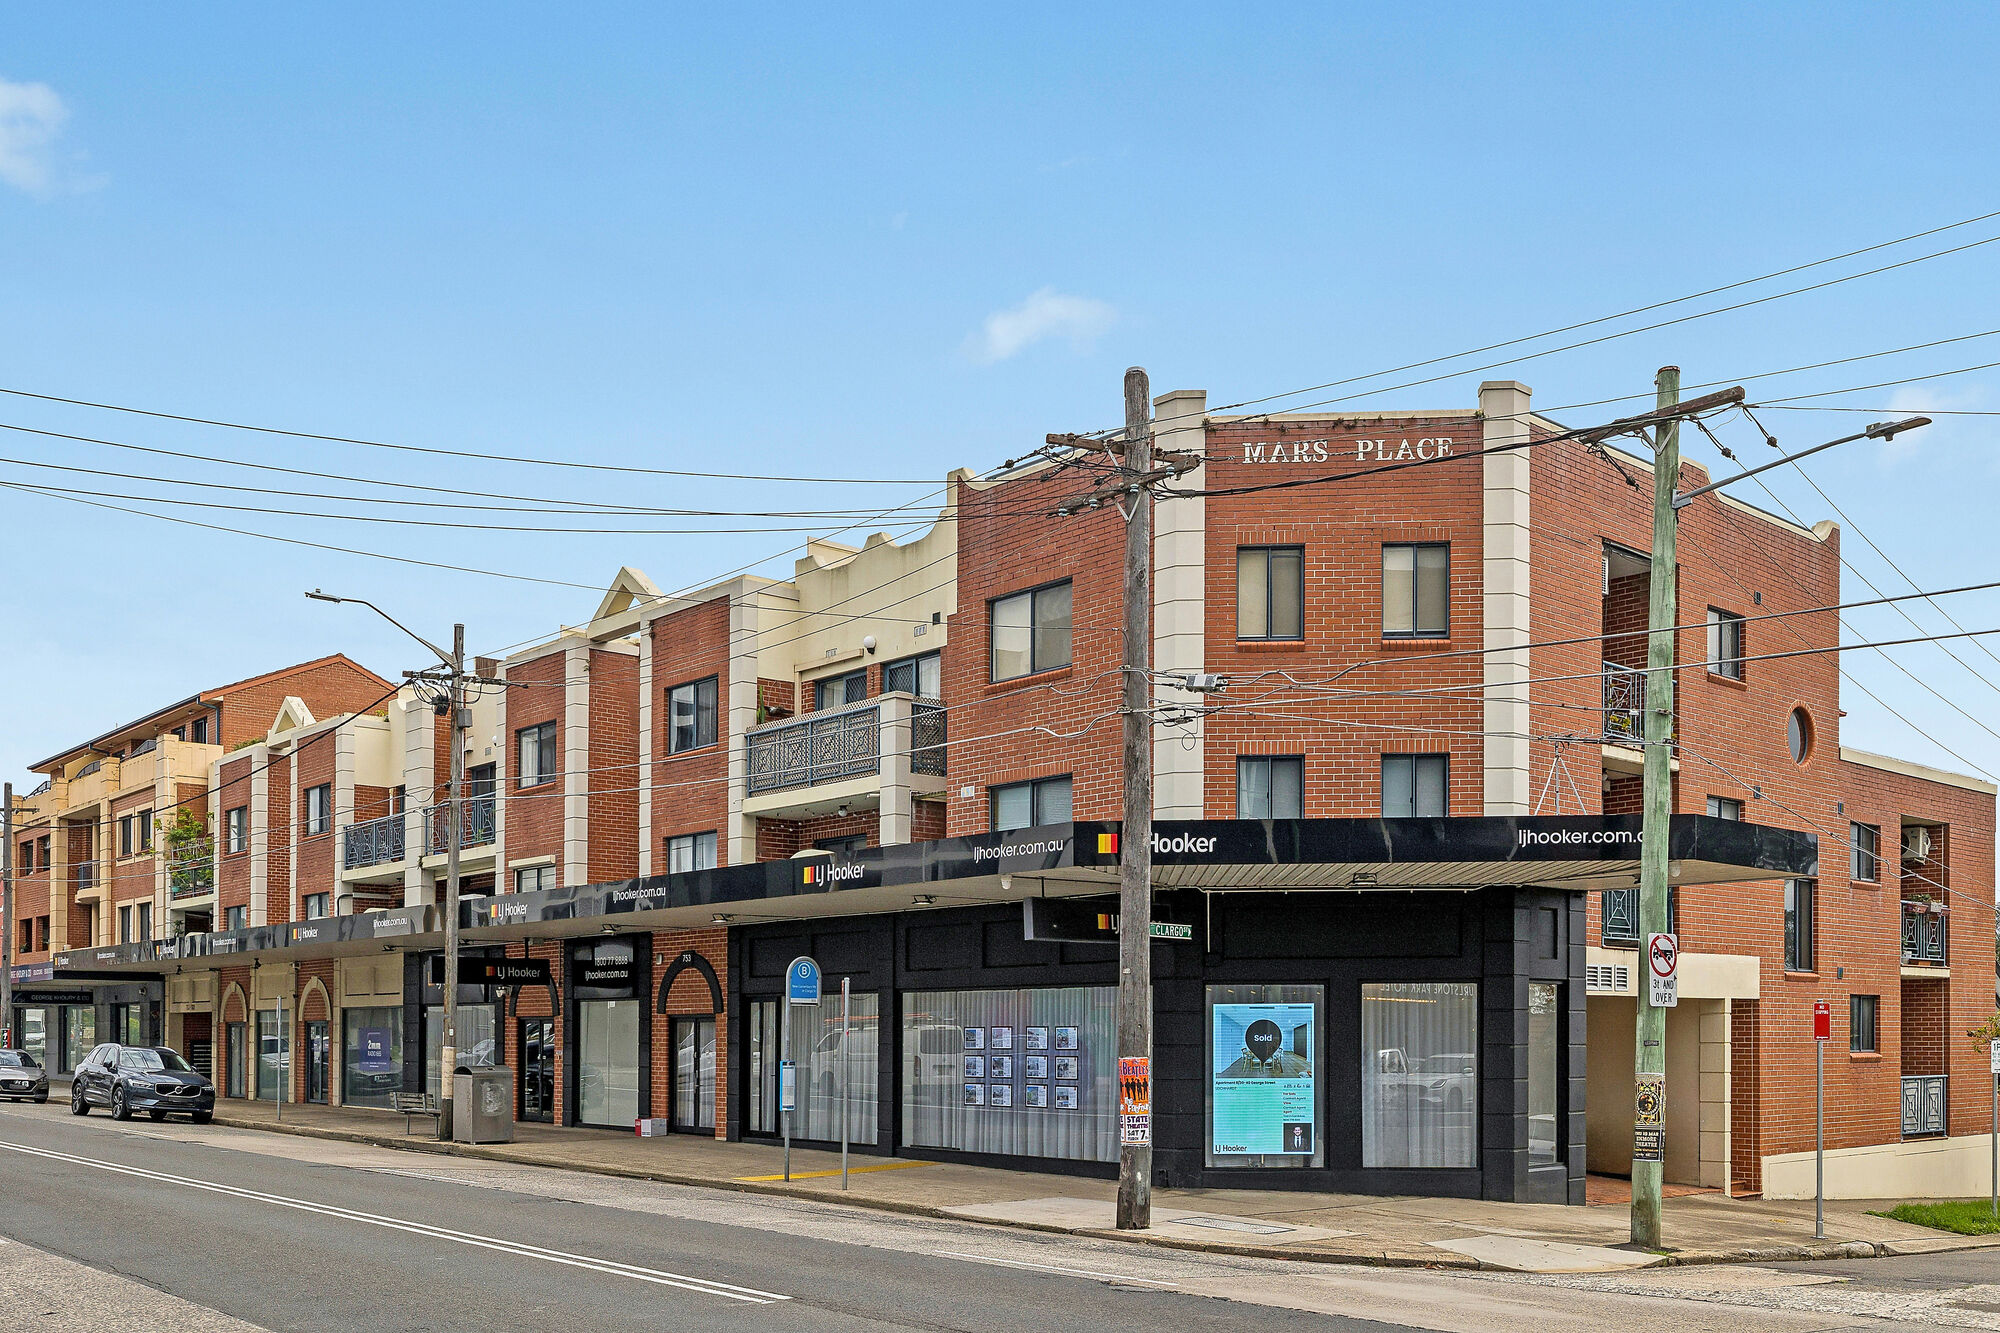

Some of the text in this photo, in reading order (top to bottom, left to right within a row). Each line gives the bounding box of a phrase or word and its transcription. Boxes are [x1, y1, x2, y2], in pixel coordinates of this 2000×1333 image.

[1242, 437, 1454, 464] MARS PLACE
[973, 839, 1064, 864] ljhooker.com.au
[815, 861, 865, 887] LJ Hooker
[612, 887, 666, 904] ljhooker.com.au
[498, 901, 528, 920] LJ Hooker
[1111, 914, 1120, 934] LJ
[302, 927, 318, 939] Hooker
[1156, 924, 1183, 937] CLARGO
[594, 957, 606, 966] 1800
[607, 956, 614, 966] 77
[682, 954, 692, 962] 753
[498, 966, 541, 980] LJ Hooker
[585, 970, 628, 981] ljhooker.com.au
[1653, 979, 1674, 990] 3t AND
[1656, 992, 1672, 1002] OVER
[1254, 1034, 1272, 1042] Sold
[1122, 1062, 1148, 1077] BEATLES
[1140, 1130, 1146, 1140] 7
[1216, 1145, 1222, 1153] LJ
